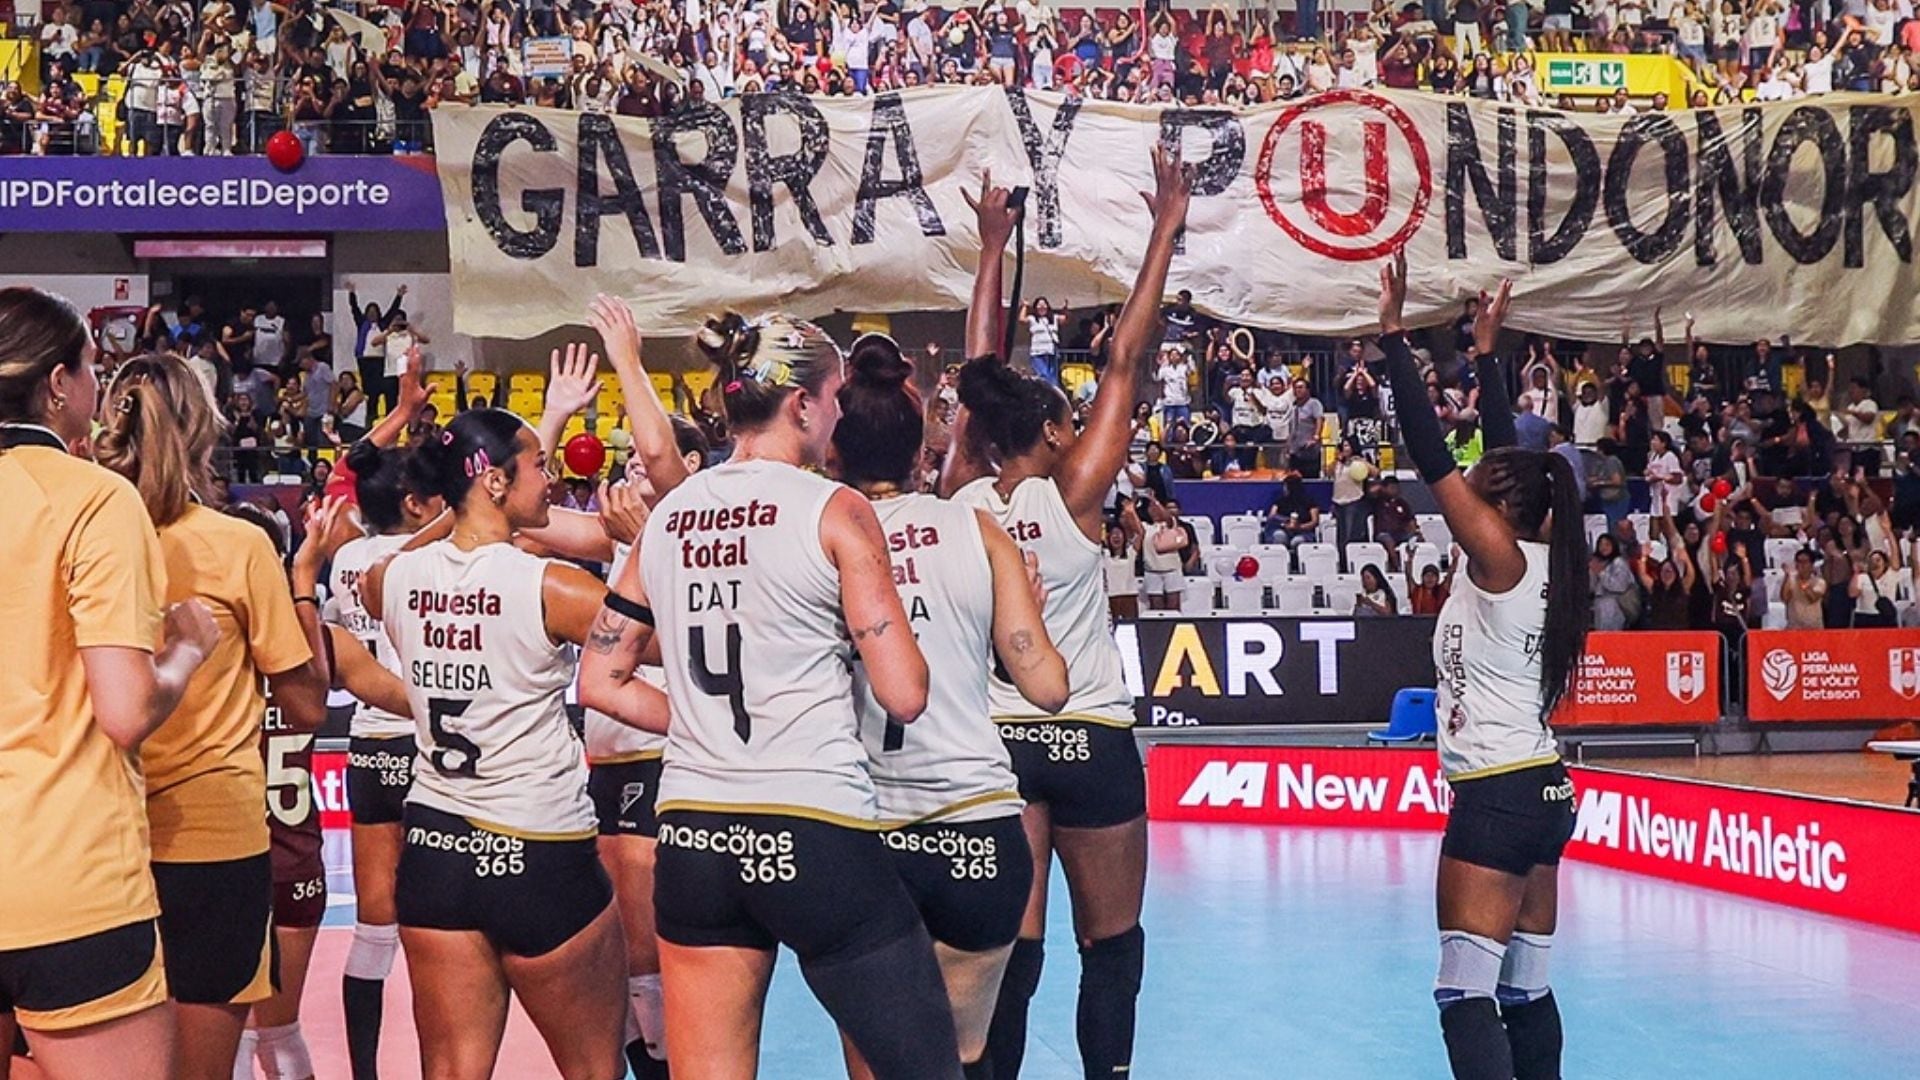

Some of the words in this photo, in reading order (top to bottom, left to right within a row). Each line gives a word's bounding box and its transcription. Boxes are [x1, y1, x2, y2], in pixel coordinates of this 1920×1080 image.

[471, 90, 945, 267] GARRA
[1005, 87, 1083, 249] Y
[1, 179, 389, 213] IPDFortaleceElDeporte
[665, 500, 778, 538] apuesta
[682, 536, 748, 569] total
[408, 588, 501, 617] apuesta
[688, 581, 741, 612] CAT
[423, 620, 482, 651] total
[1451, 624, 1467, 698] WORLD
[1801, 652, 1829, 662] LIGA
[1802, 664, 1857, 674] PERUANA
[412, 661, 492, 690] SELEISA
[688, 623, 751, 745] 4
[1803, 677, 1818, 687] DE
[1577, 693, 1637, 703] betsson
[1803, 689, 1860, 700] betsson
[429, 697, 482, 778] 5
[995, 724, 1088, 744] ascotas
[347, 751, 410, 770] ascotas
[1048, 743, 1090, 761] 365
[265, 733, 313, 826] 5
[380, 769, 409, 786] 365
[1278, 764, 1388, 811] New
[408, 827, 524, 854] mascotas
[660, 823, 794, 855] mascotas
[1627, 796, 1697, 864] New
[1703, 808, 1848, 892] Athletic
[475, 852, 525, 877] 365
[740, 854, 797, 883] 365
[951, 856, 998, 879] 365
[293, 876, 323, 900] 365
